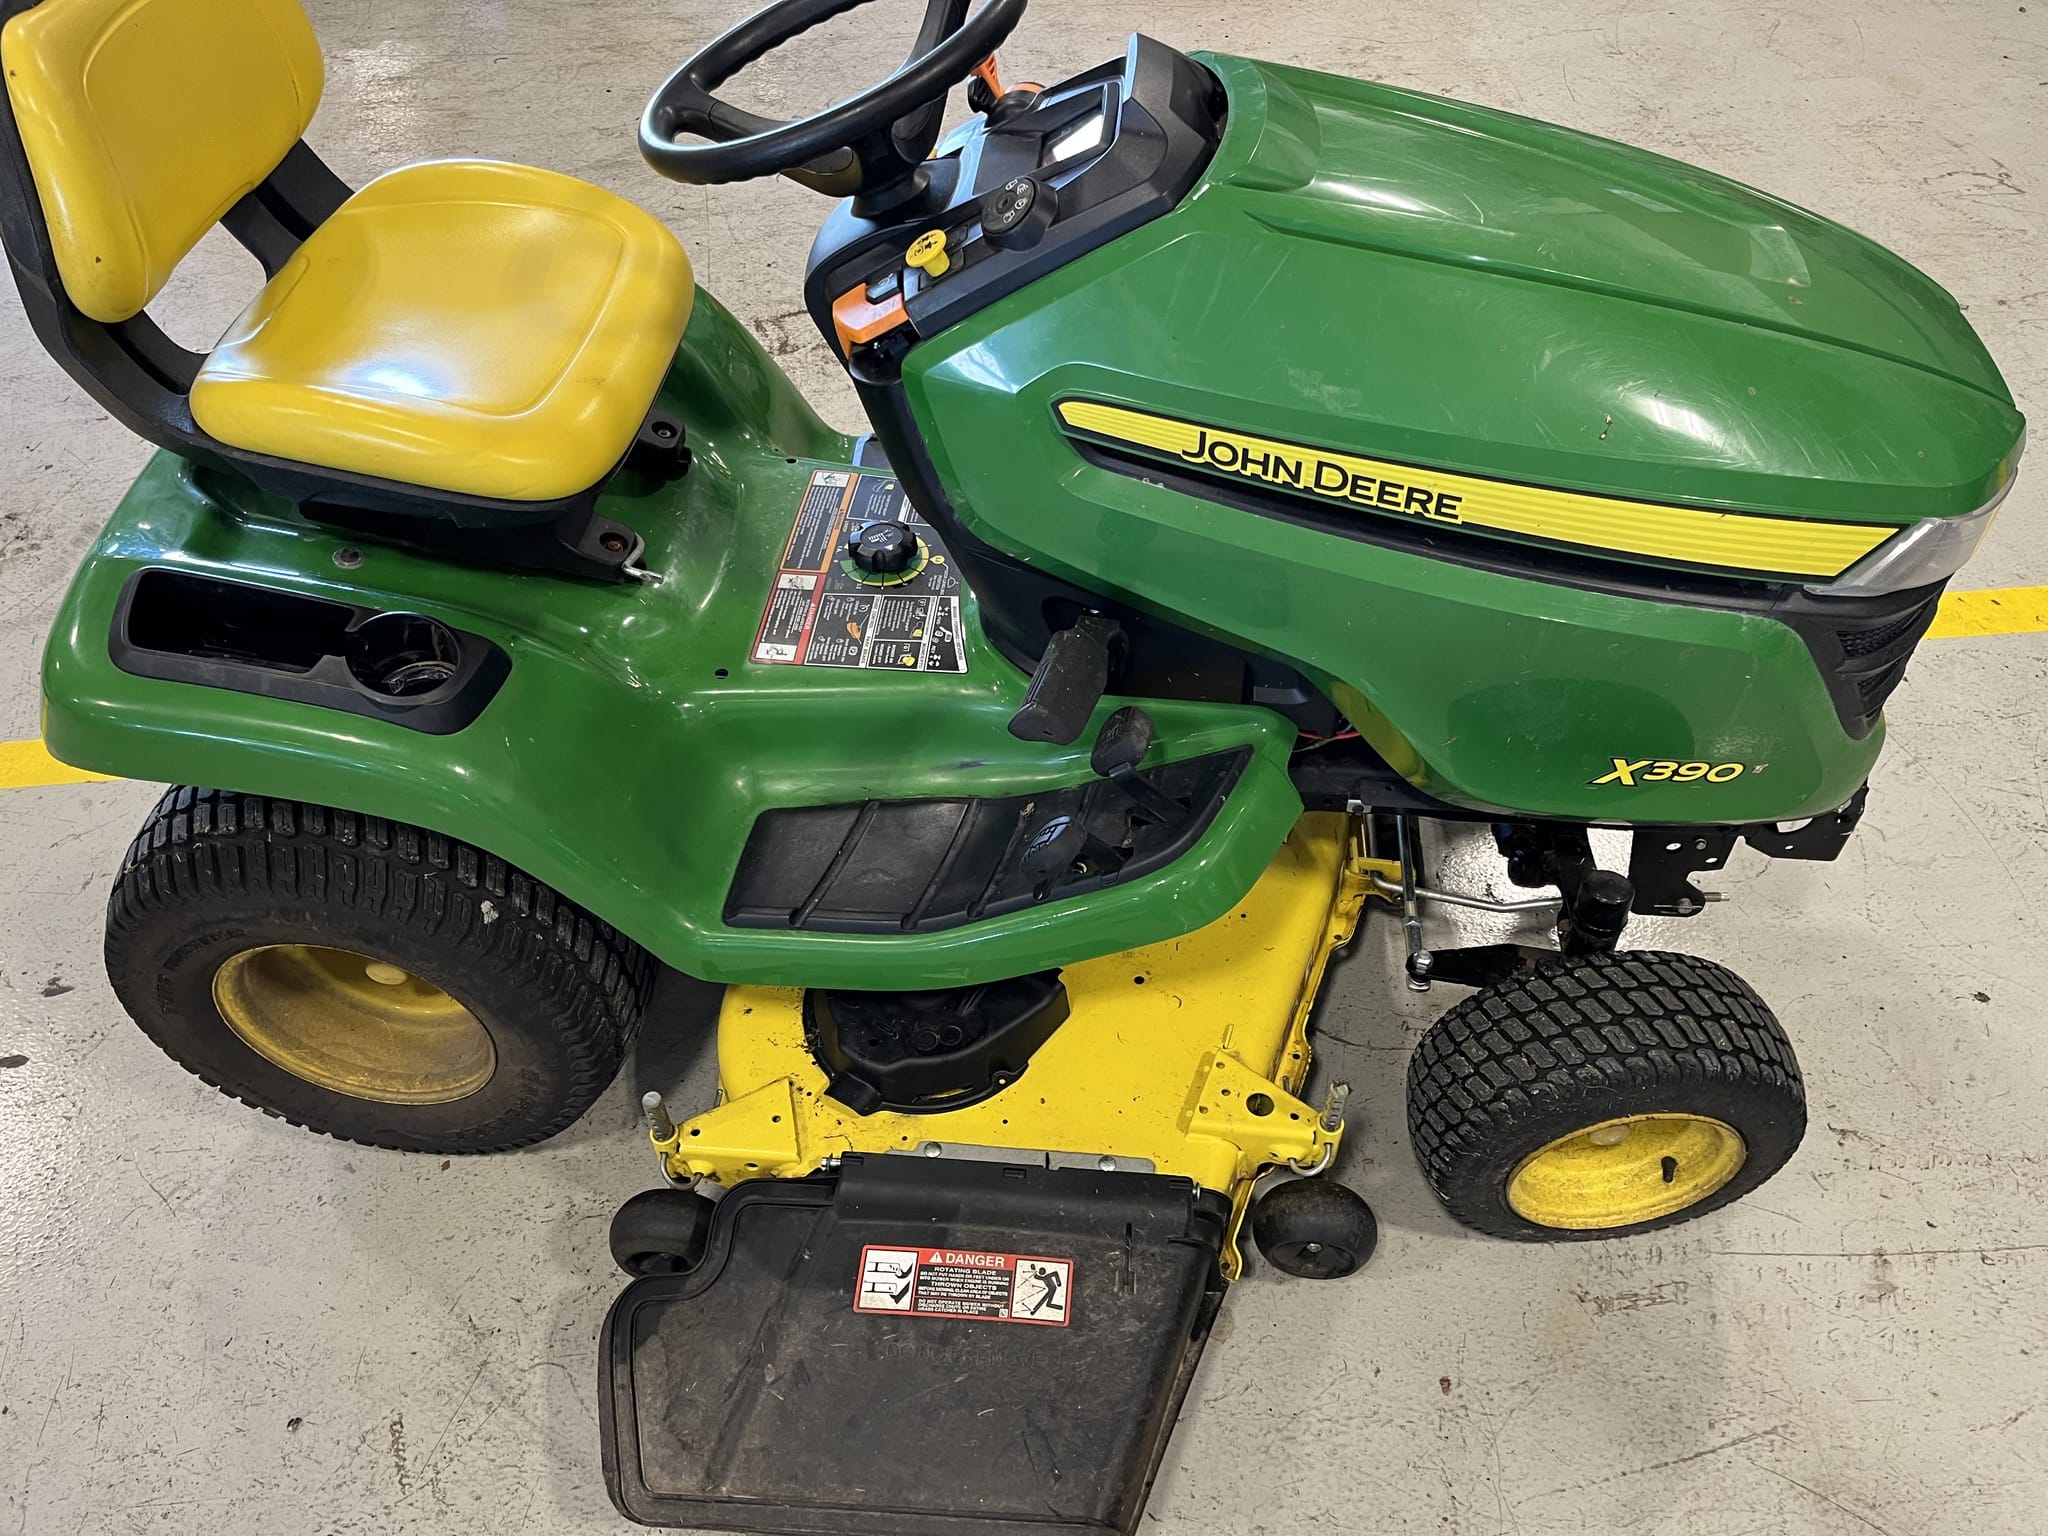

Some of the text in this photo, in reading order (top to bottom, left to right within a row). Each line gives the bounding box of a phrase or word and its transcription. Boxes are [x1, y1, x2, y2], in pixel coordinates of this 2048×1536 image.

[1182, 431, 1463, 520] JOHN DEERE
[1587, 757, 1746, 786] X390
[946, 1253, 1005, 1267] DANGER
